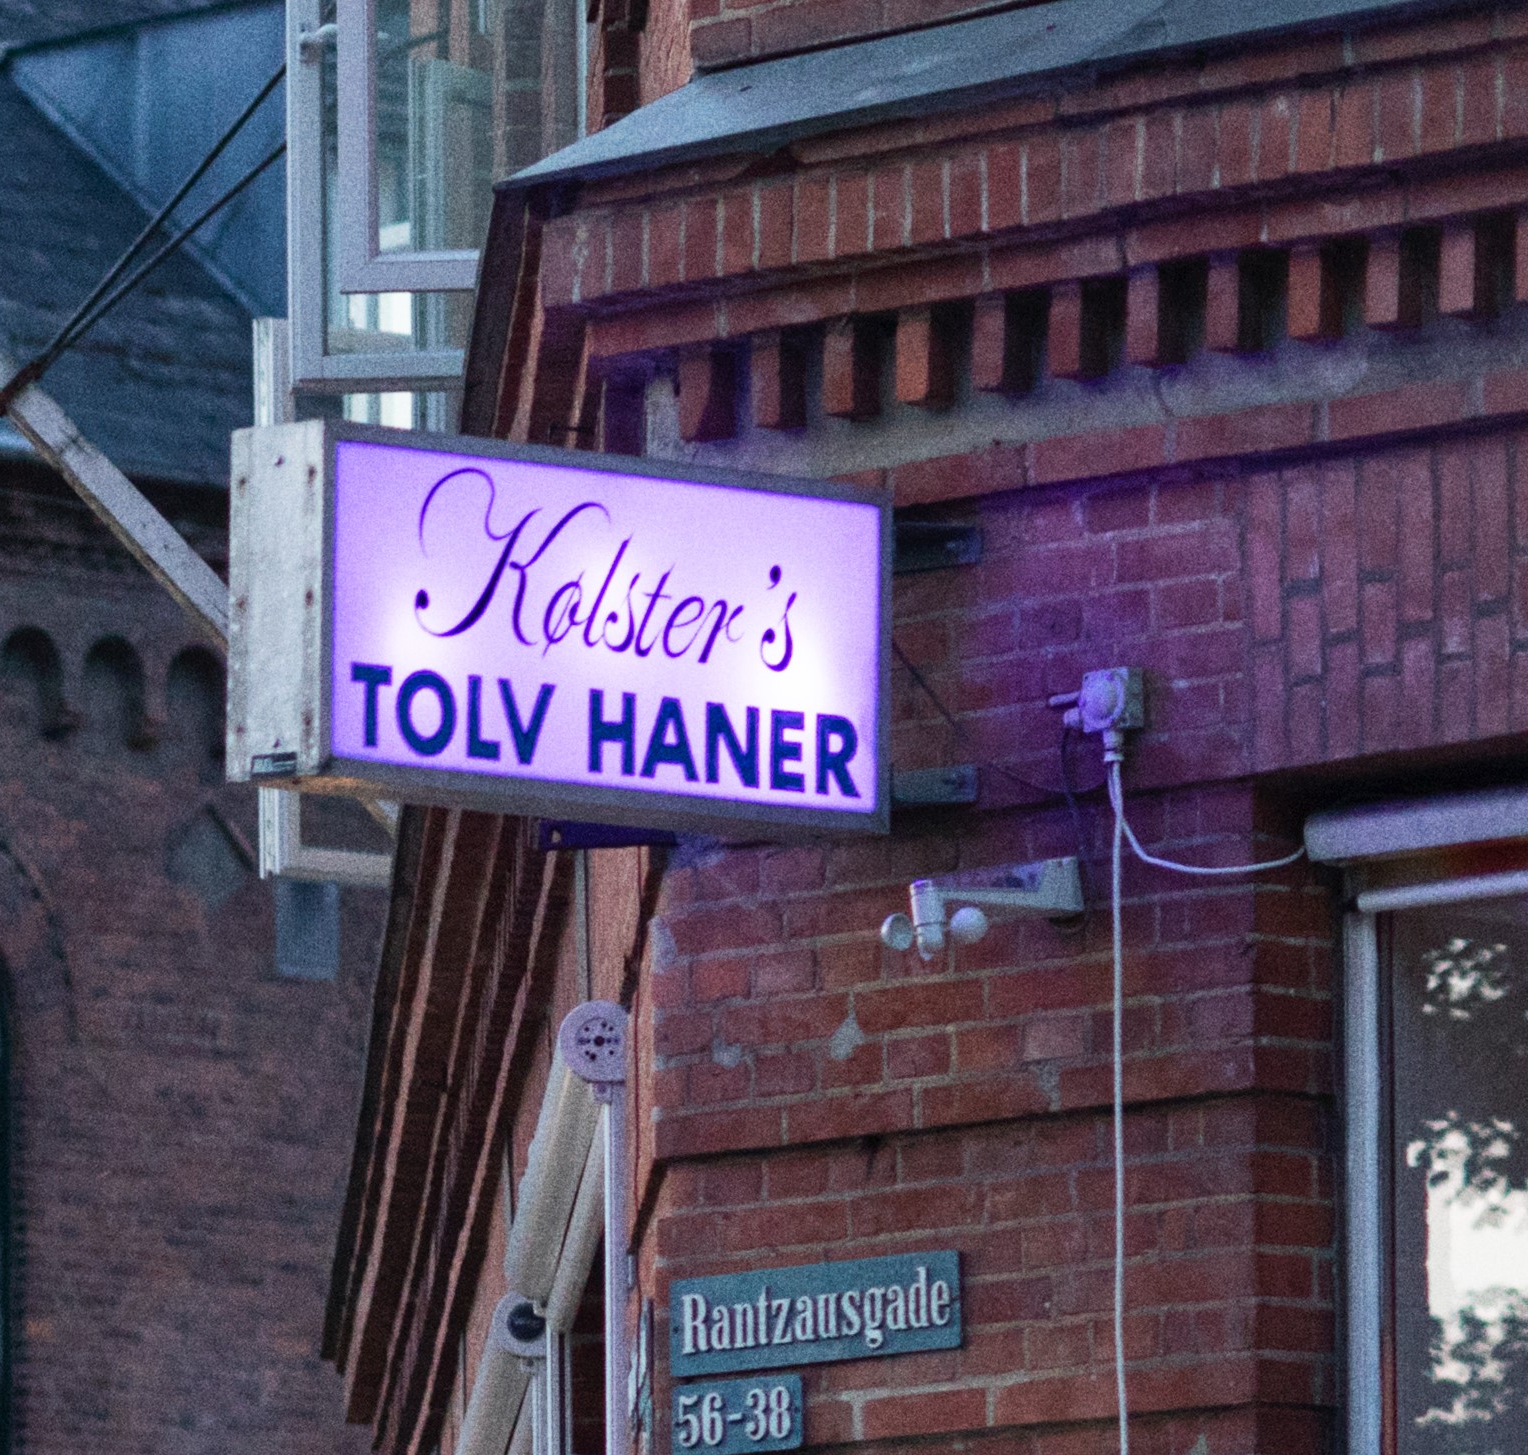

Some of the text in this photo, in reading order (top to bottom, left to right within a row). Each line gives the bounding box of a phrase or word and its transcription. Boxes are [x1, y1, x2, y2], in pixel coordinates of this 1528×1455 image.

[351, 664, 861, 798] TOLV HANER
[681, 1267, 951, 1355] Rantzausgade
[676, 1386, 792, 1448] 56-38
